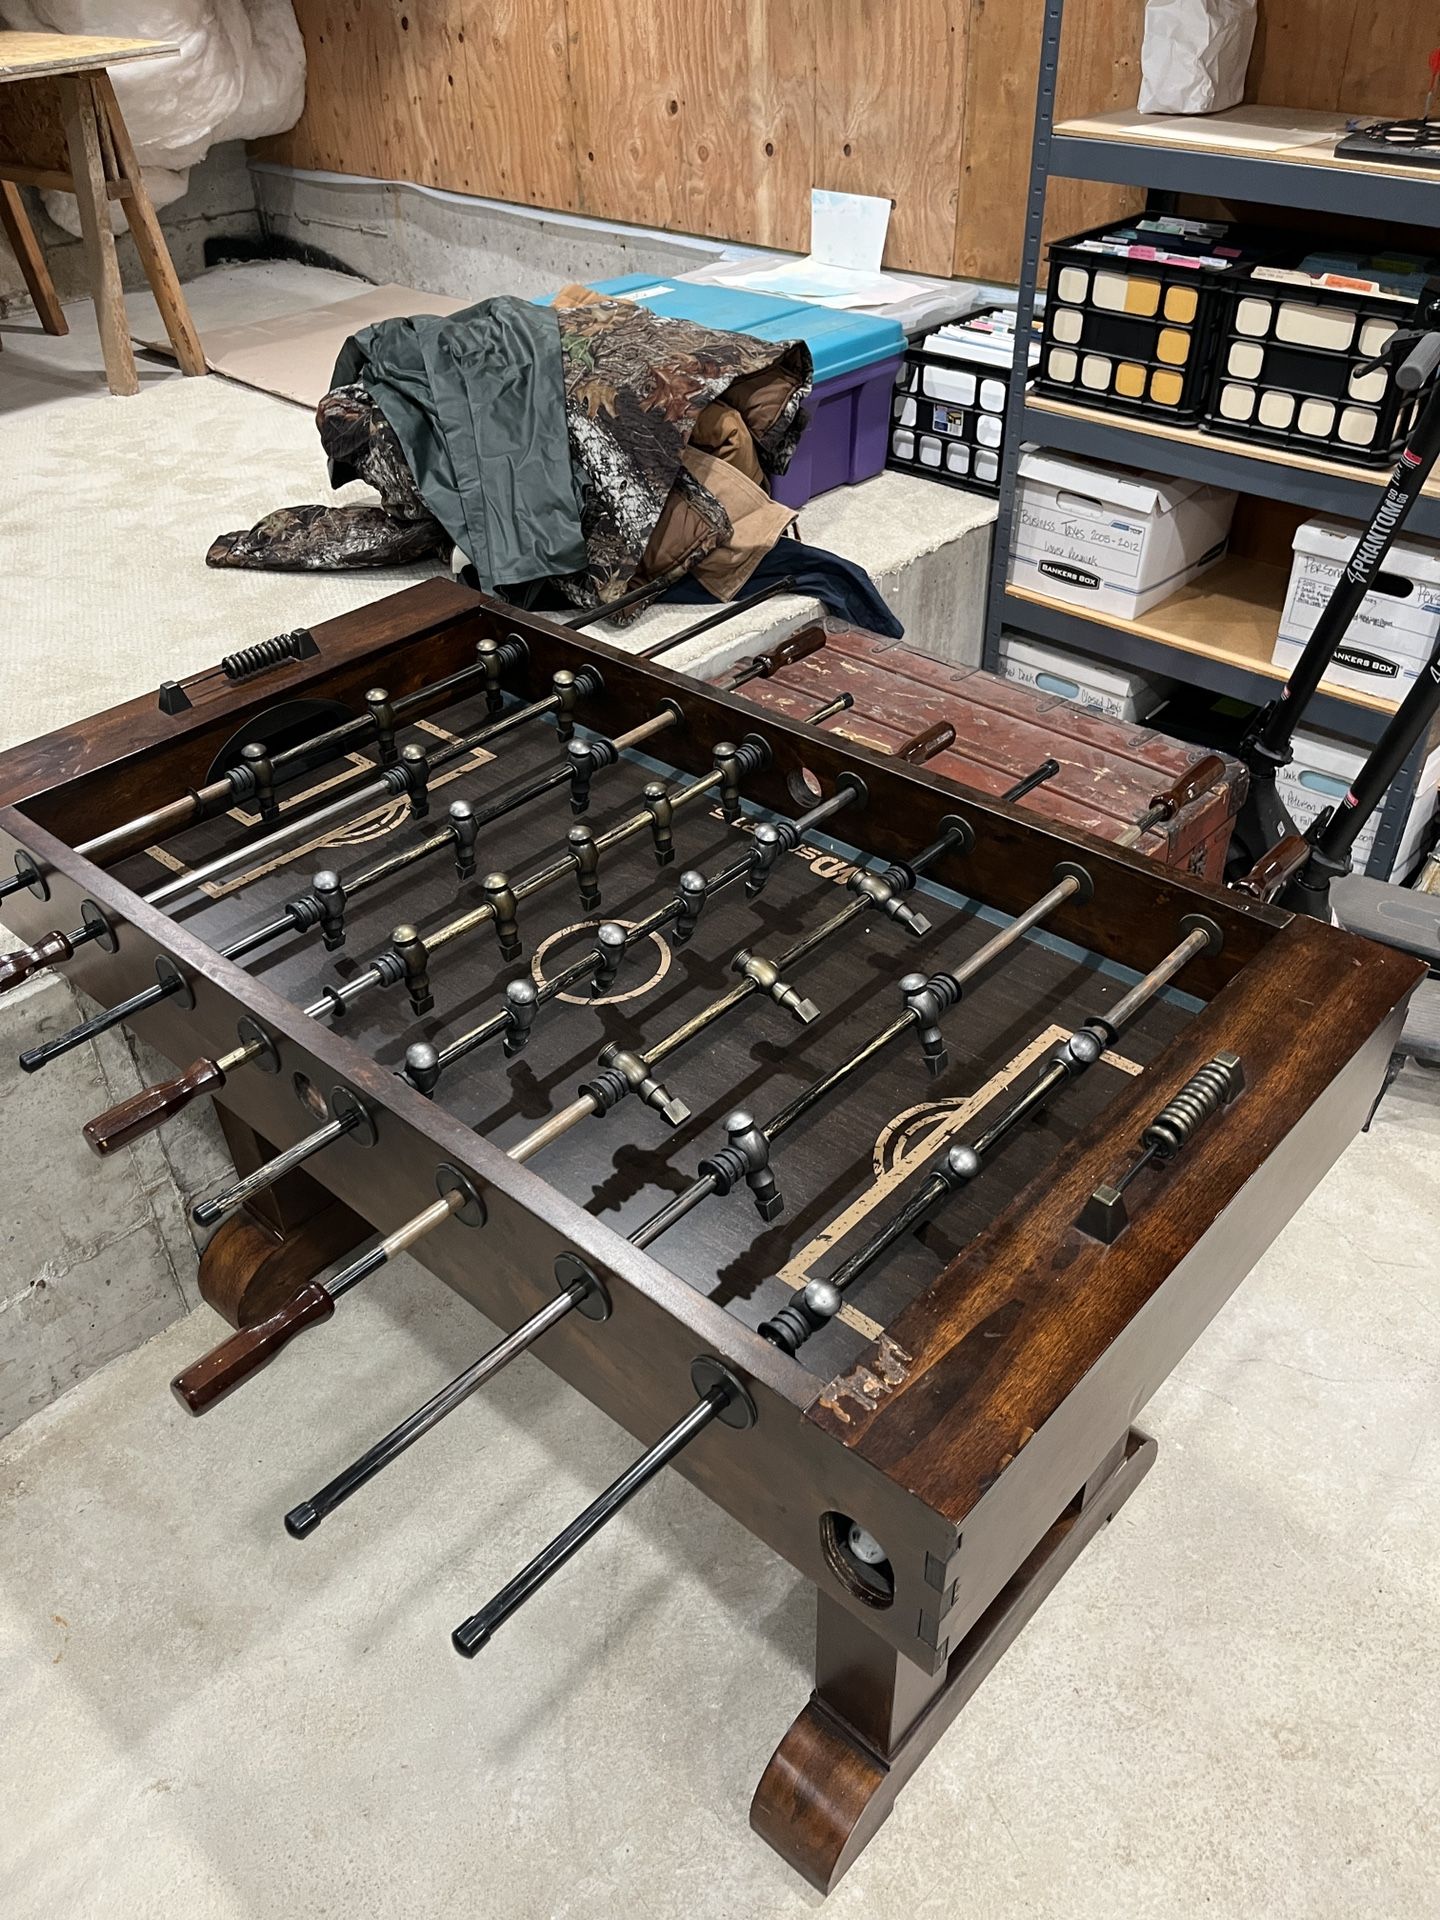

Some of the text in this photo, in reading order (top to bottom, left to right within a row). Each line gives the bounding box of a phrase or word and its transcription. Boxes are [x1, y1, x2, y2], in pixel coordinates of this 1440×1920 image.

[1061, 519, 1086, 540] Taxes
[1351, 498, 1404, 574] PHANTOM
[1042, 563, 1096, 586] BANKERS BOX
[1333, 652, 1394, 674] ANKERS BOX
